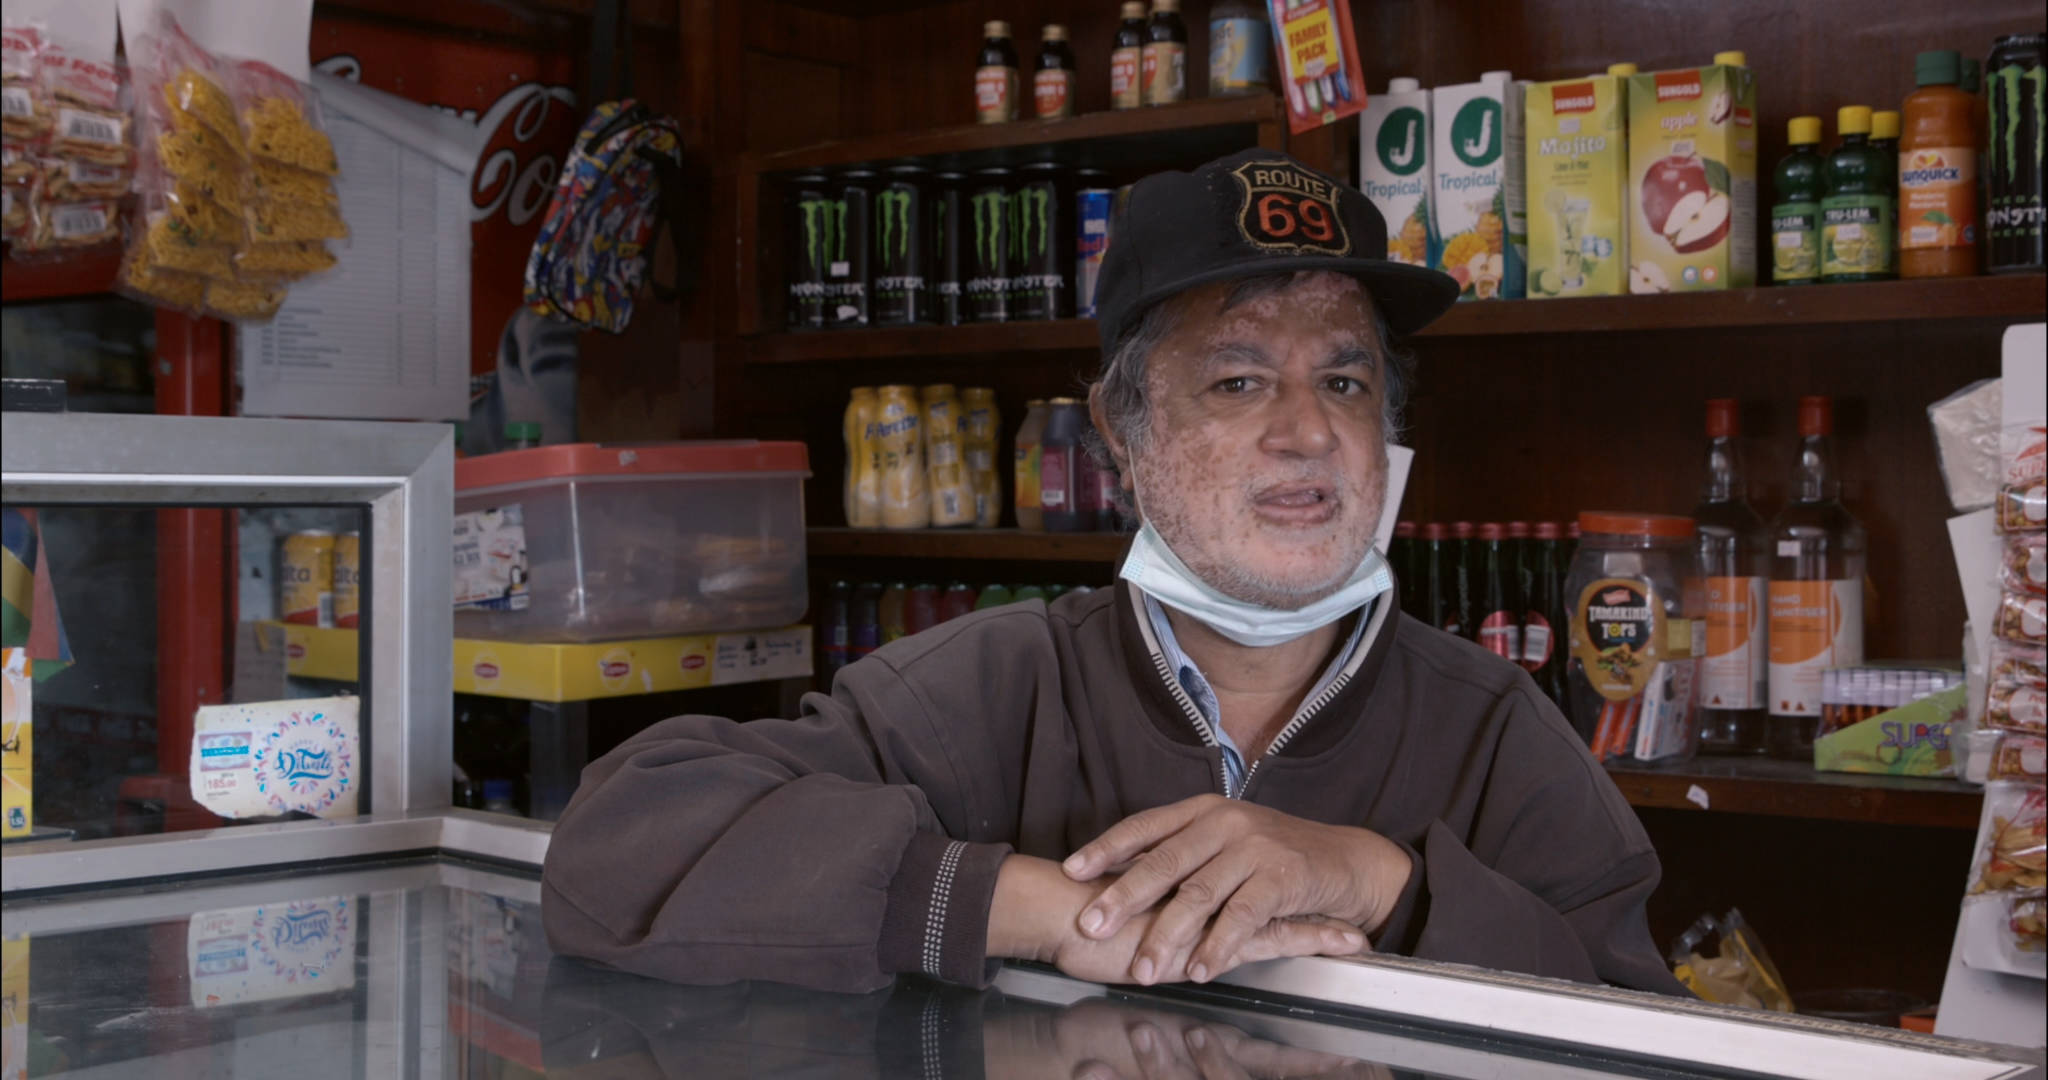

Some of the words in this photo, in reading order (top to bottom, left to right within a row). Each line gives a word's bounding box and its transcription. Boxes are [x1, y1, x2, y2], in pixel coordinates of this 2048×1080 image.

[1289, 21, 1328, 49] FAMILY
[1296, 40, 1328, 66] PACK
[1464, 110, 1494, 158] J
[1660, 112, 1699, 134] apple
[1389, 119, 1418, 167] J
[1539, 136, 1607, 160] Mojito
[1254, 169, 1328, 199] ROUTE
[1365, 179, 1424, 202] Tropical
[1439, 169, 1498, 195] Tropical
[1258, 193, 1335, 241] 69
[1588, 606, 1649, 622] TAMARIND
[1601, 622, 1637, 639] TOPS
